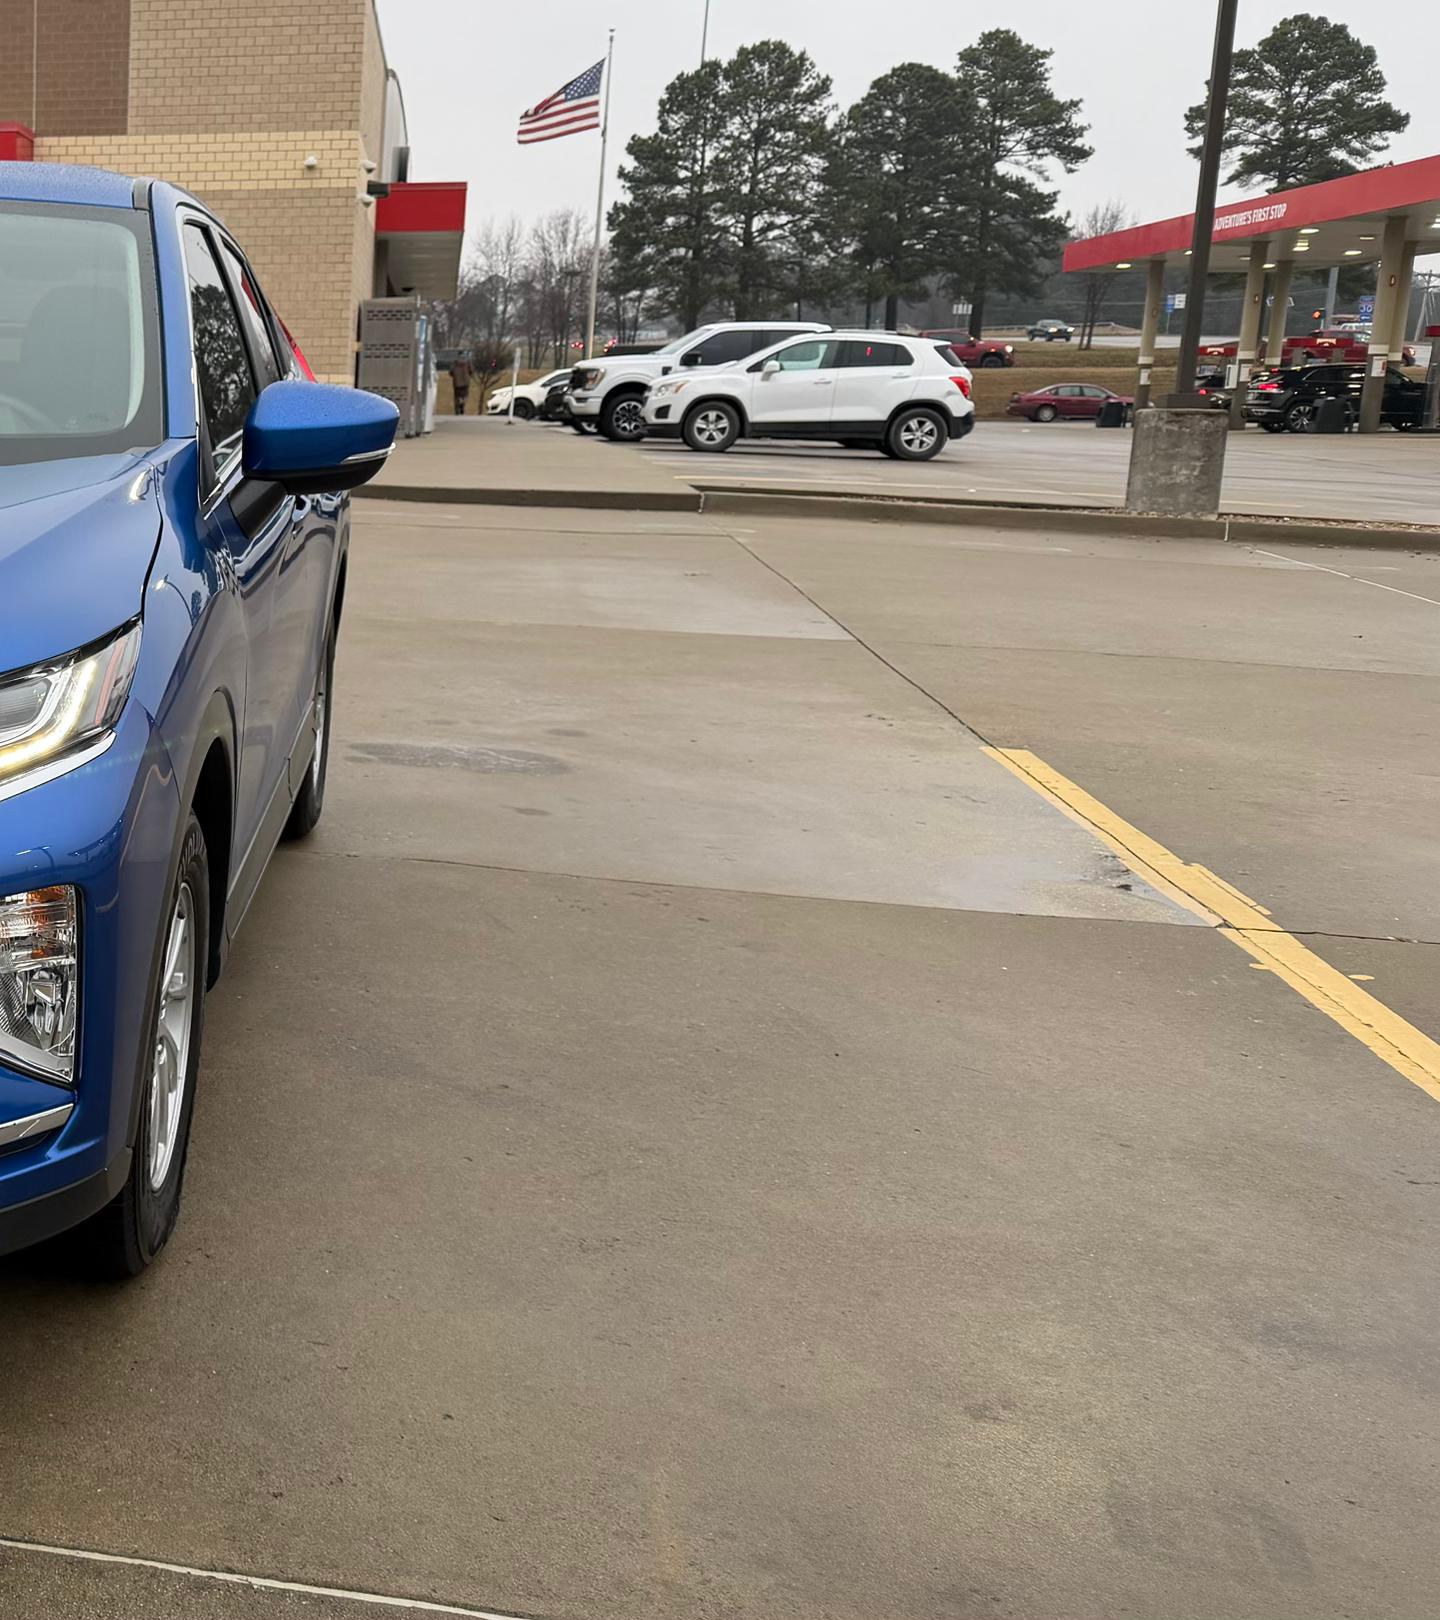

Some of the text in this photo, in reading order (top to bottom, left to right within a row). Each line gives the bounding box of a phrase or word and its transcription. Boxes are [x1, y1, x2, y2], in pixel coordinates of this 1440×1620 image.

[1213, 203, 1287, 231] ADVENTURE'S FIRST STOP
